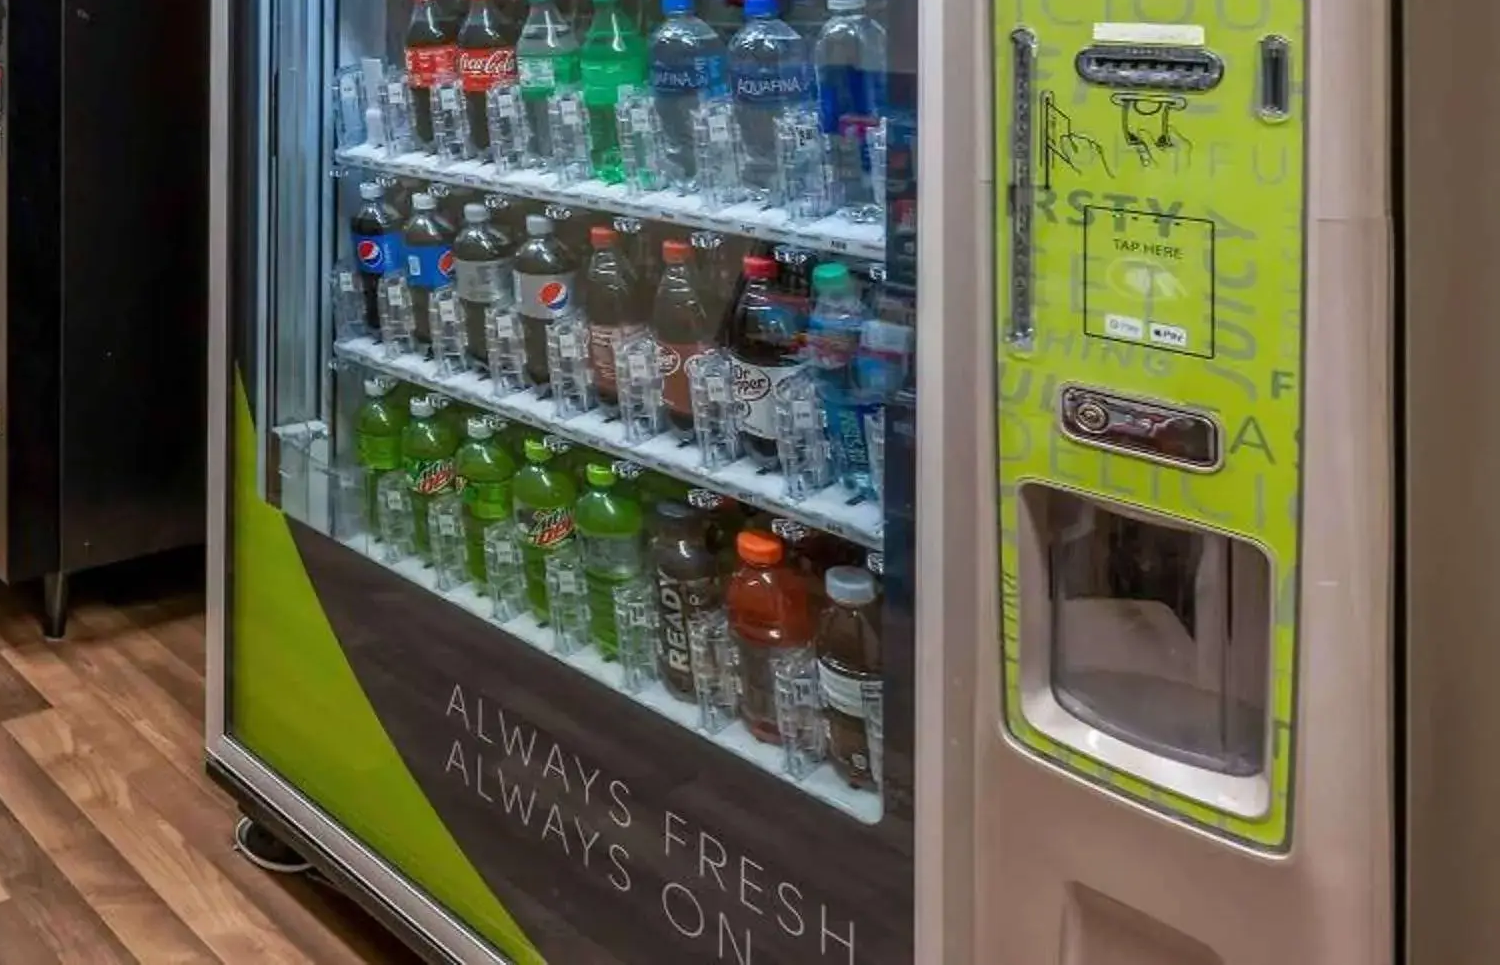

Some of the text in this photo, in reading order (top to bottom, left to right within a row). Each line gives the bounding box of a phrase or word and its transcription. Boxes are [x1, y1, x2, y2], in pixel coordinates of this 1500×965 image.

[736, 75, 803, 96] AQUAFINA
[1112, 238, 1185, 260] TAP HERE
[658, 565, 690, 673] READY
[446, 684, 855, 965] ALWAYS FRESH
[446, 739, 751, 965] ALWAYS ON
